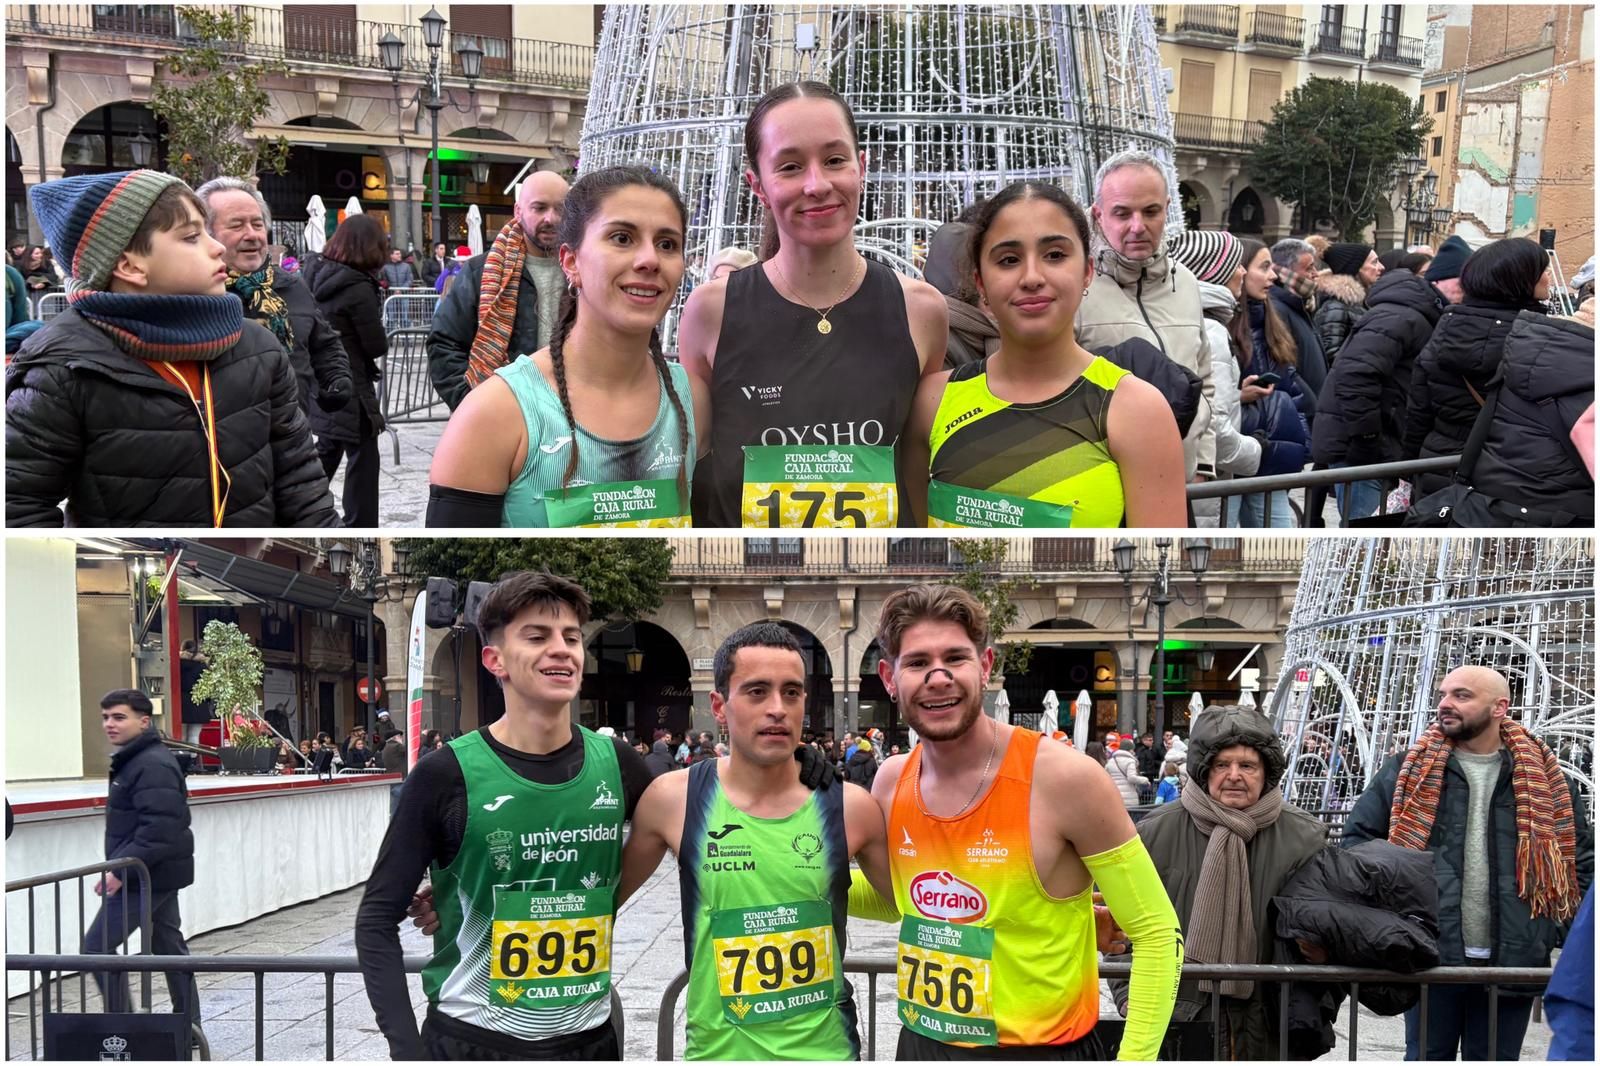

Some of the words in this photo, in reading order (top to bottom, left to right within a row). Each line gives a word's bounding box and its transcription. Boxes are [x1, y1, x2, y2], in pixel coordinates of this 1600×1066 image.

[757, 385, 783, 394] VICKY
[760, 392, 781, 400] FOODS
[761, 419, 884, 446] OYSHO
[784, 463, 814, 474] CAJA
[815, 463, 854, 474] RURAL
[593, 502, 620, 514] CAJA
[622, 499, 657, 512] RURAL
[756, 489, 867, 528] 175
[956, 505, 983, 519] CAJA
[985, 509, 1023, 527] RURAL
[965, 517, 993, 527] ZAMORA
[520, 823, 618, 847] universidad
[522, 848, 539, 861] de
[541, 844, 578, 864] león
[966, 847, 1008, 857] SERRANO
[712, 861, 756, 872] UCLM
[916, 883, 980, 910] Serrano
[530, 904, 553, 913] CAJA
[555, 903, 586, 912] RURAL
[744, 918, 767, 929] CAJA
[768, 915, 799, 926] RURAL
[917, 931, 934, 942] CAJA
[935, 933, 961, 947] RURAL
[500, 929, 597, 978] 695
[722, 940, 816, 993] 799
[526, 987, 560, 999] CAJA
[563, 981, 605, 997] RURAL
[902, 955, 974, 1014] 756
[754, 998, 788, 1014] CAJA
[788, 990, 828, 1008] RURAL
[920, 1014, 943, 1031] CAJA
[944, 1021, 991, 1037] RURAL
